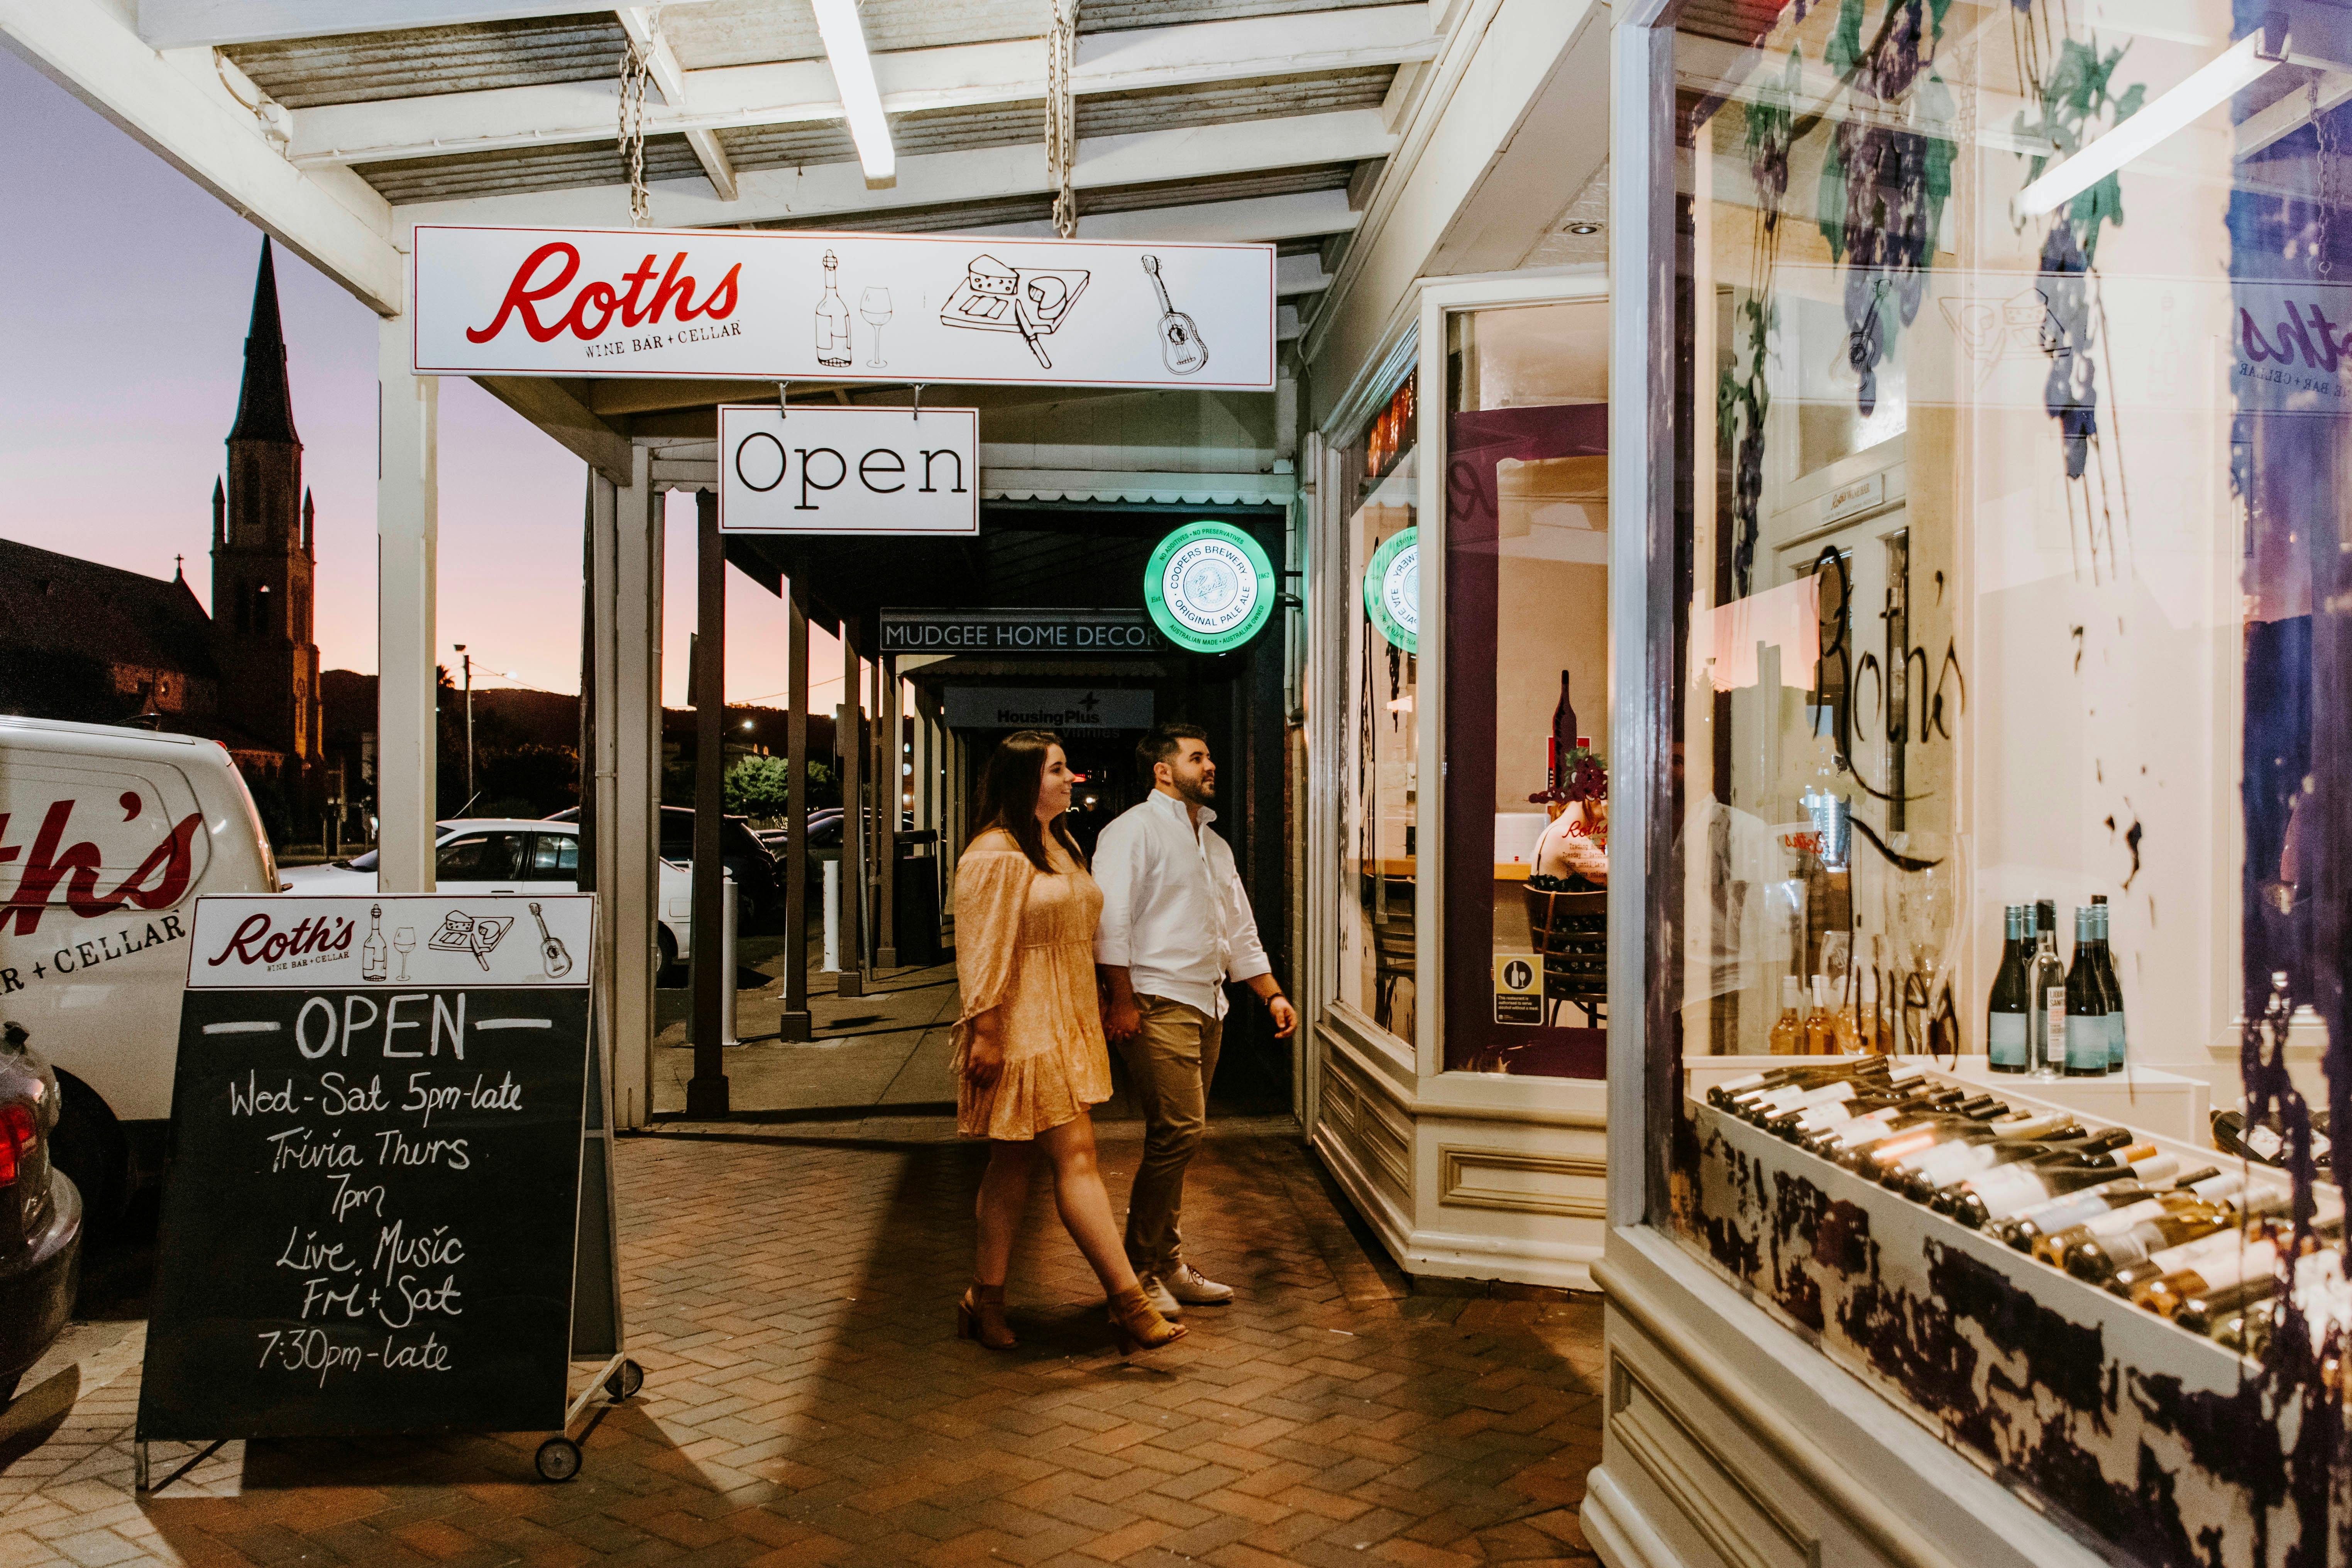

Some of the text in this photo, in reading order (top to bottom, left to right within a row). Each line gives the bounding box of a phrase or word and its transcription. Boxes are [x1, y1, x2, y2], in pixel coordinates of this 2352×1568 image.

[466, 242, 742, 343] Roths
[585, 342, 624, 358] WINE
[633, 335, 663, 352] BAR
[678, 321, 741, 343] CELLAR
[736, 431, 967, 510] Open
[1159, 552, 1166, 561] NO
[1165, 534, 1189, 553] ADDITIVES
[1202, 529, 1244, 545] PRESERVATIVES
[1171, 546, 1247, 589] COOPERS BREWERY
[1169, 624, 1200, 644] AUSTRALIAN
[1223, 624, 1253, 644] AUSTRALIAN
[1252, 605, 1264, 624] OWNED
[1175, 587, 1250, 626] ORIGINAL PALE ALE
[886, 625, 1159, 646] MUDGEE HOME DECOR
[1562, 820, 1607, 838] Roths
[54, 909, 185, 973] CELLAR
[208, 913, 355, 967] Roth's
[267, 962, 287, 972] WINE
[291, 959, 308, 968] BAR
[315, 950, 349, 963] CELLAR
[296, 992, 466, 1061] OPEN
[267, 1126, 470, 1172] Trivia Thurs
[327, 1173, 385, 1223] 7pm
[372, 1219, 465, 1287] Music
[302, 1270, 364, 1318] Fri
[380, 1275, 463, 1328] Sat
